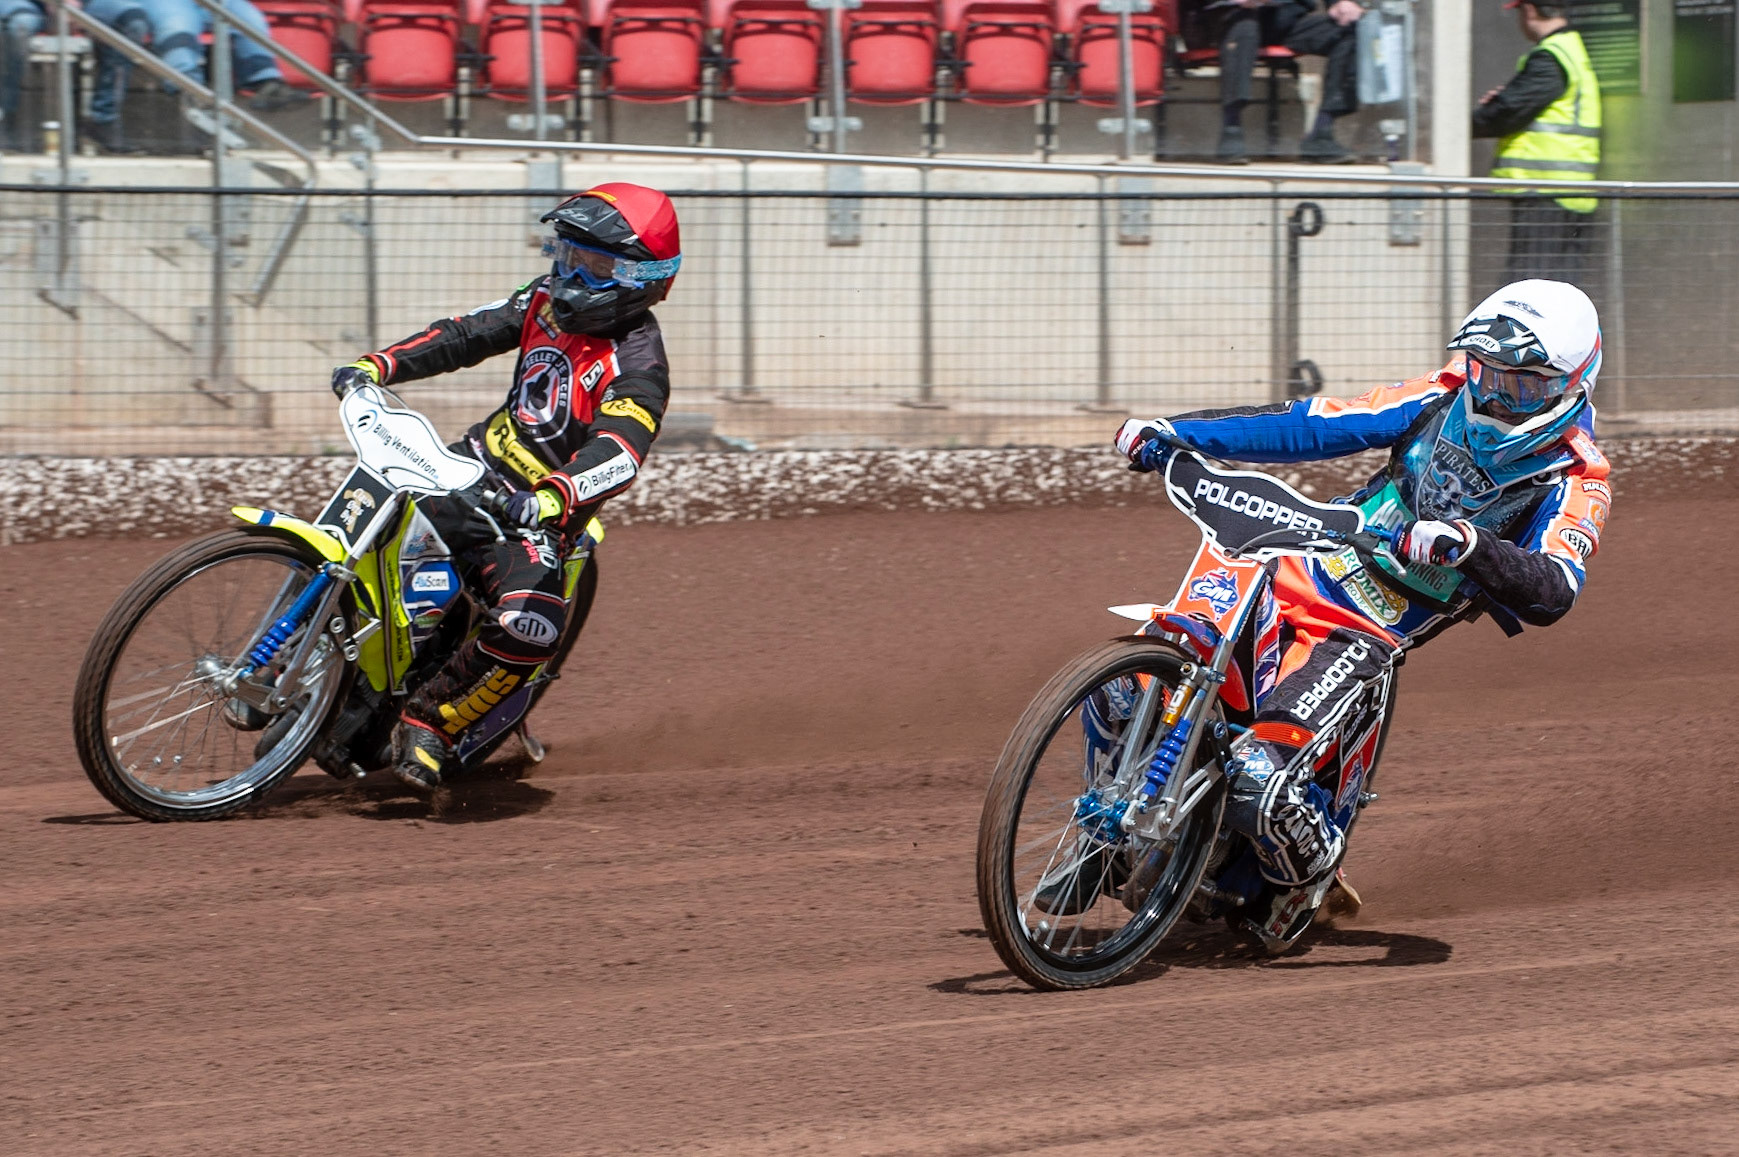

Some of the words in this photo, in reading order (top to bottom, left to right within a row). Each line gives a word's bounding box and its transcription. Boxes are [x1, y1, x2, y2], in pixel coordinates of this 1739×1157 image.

[373, 423, 393, 446] Billig
[1435, 444, 1489, 493] PIRATES
[1194, 478, 1324, 541] POLCOPPER
[1193, 580, 1233, 602] GM
[514, 617, 547, 637] GM
